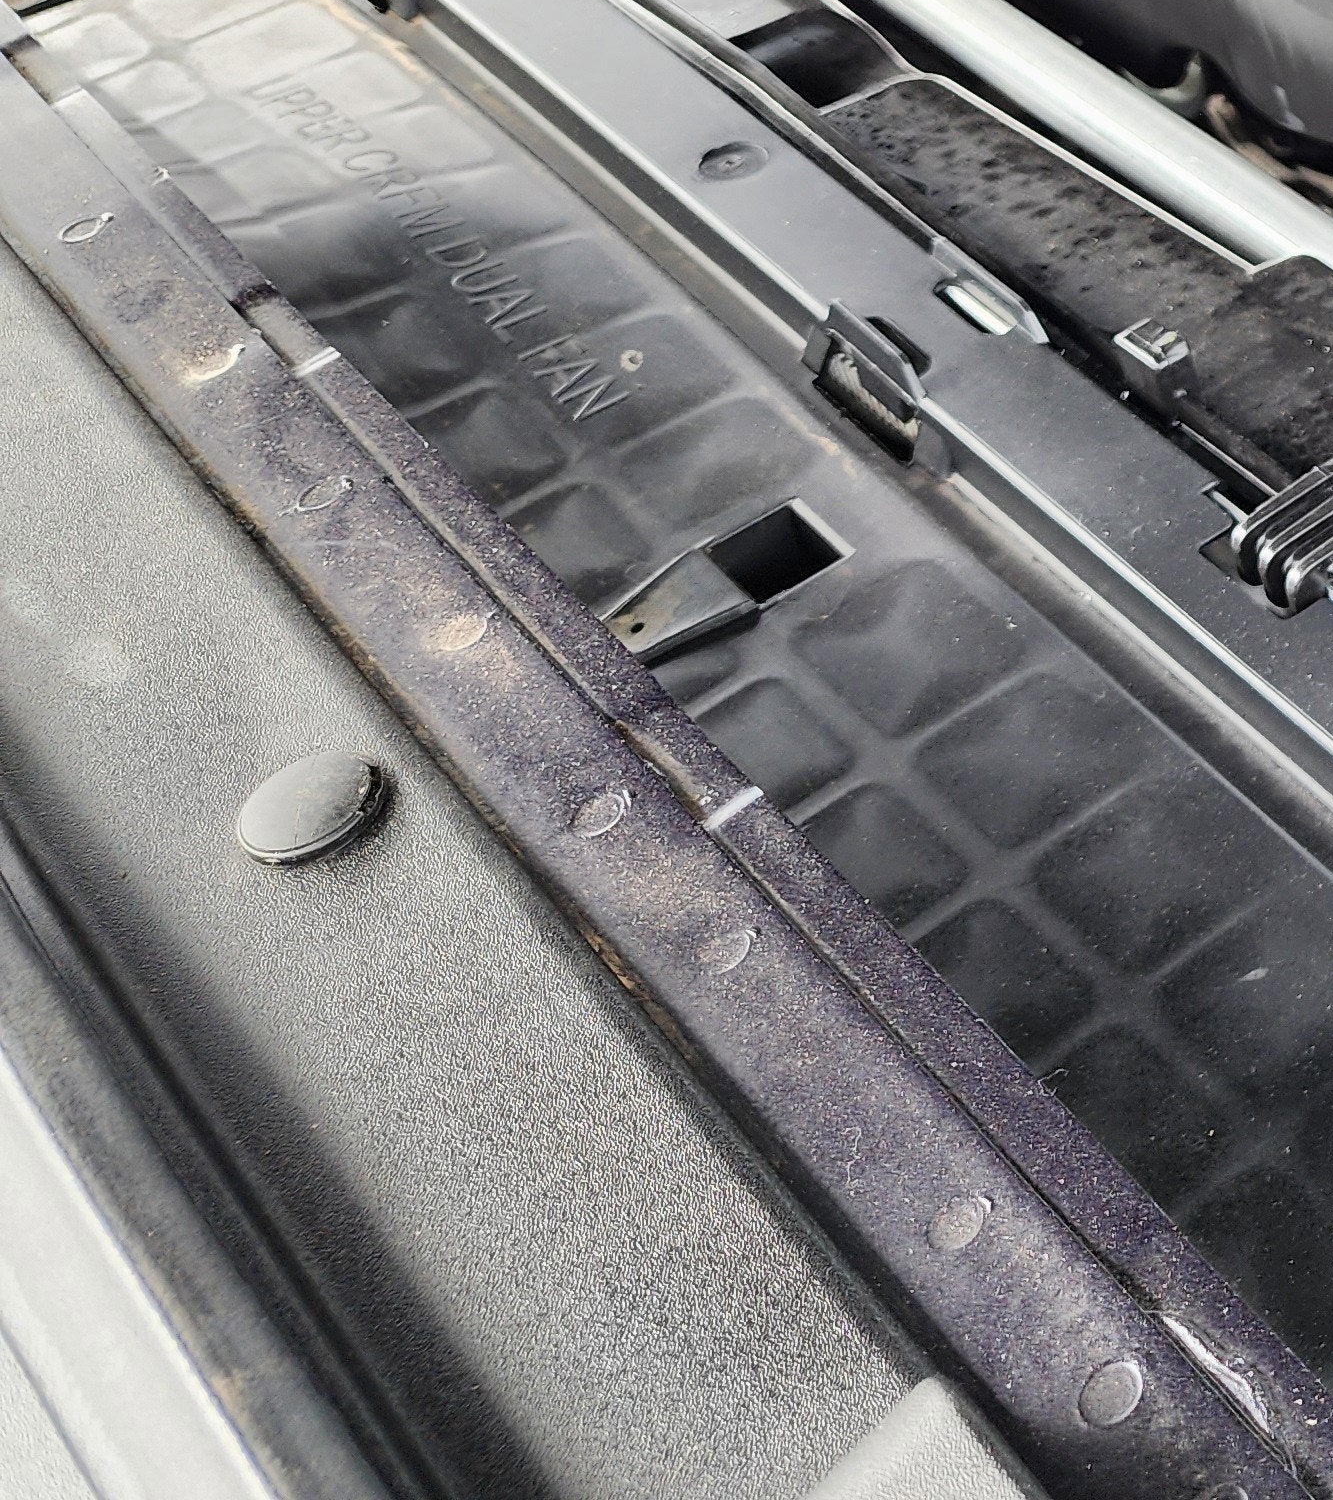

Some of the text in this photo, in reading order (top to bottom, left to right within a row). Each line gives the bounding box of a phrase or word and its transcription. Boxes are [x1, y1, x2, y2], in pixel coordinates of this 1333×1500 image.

[242, 74, 371, 152] UPPER
[424, 236, 549, 344] DUAL
[517, 332, 633, 423] FAN
